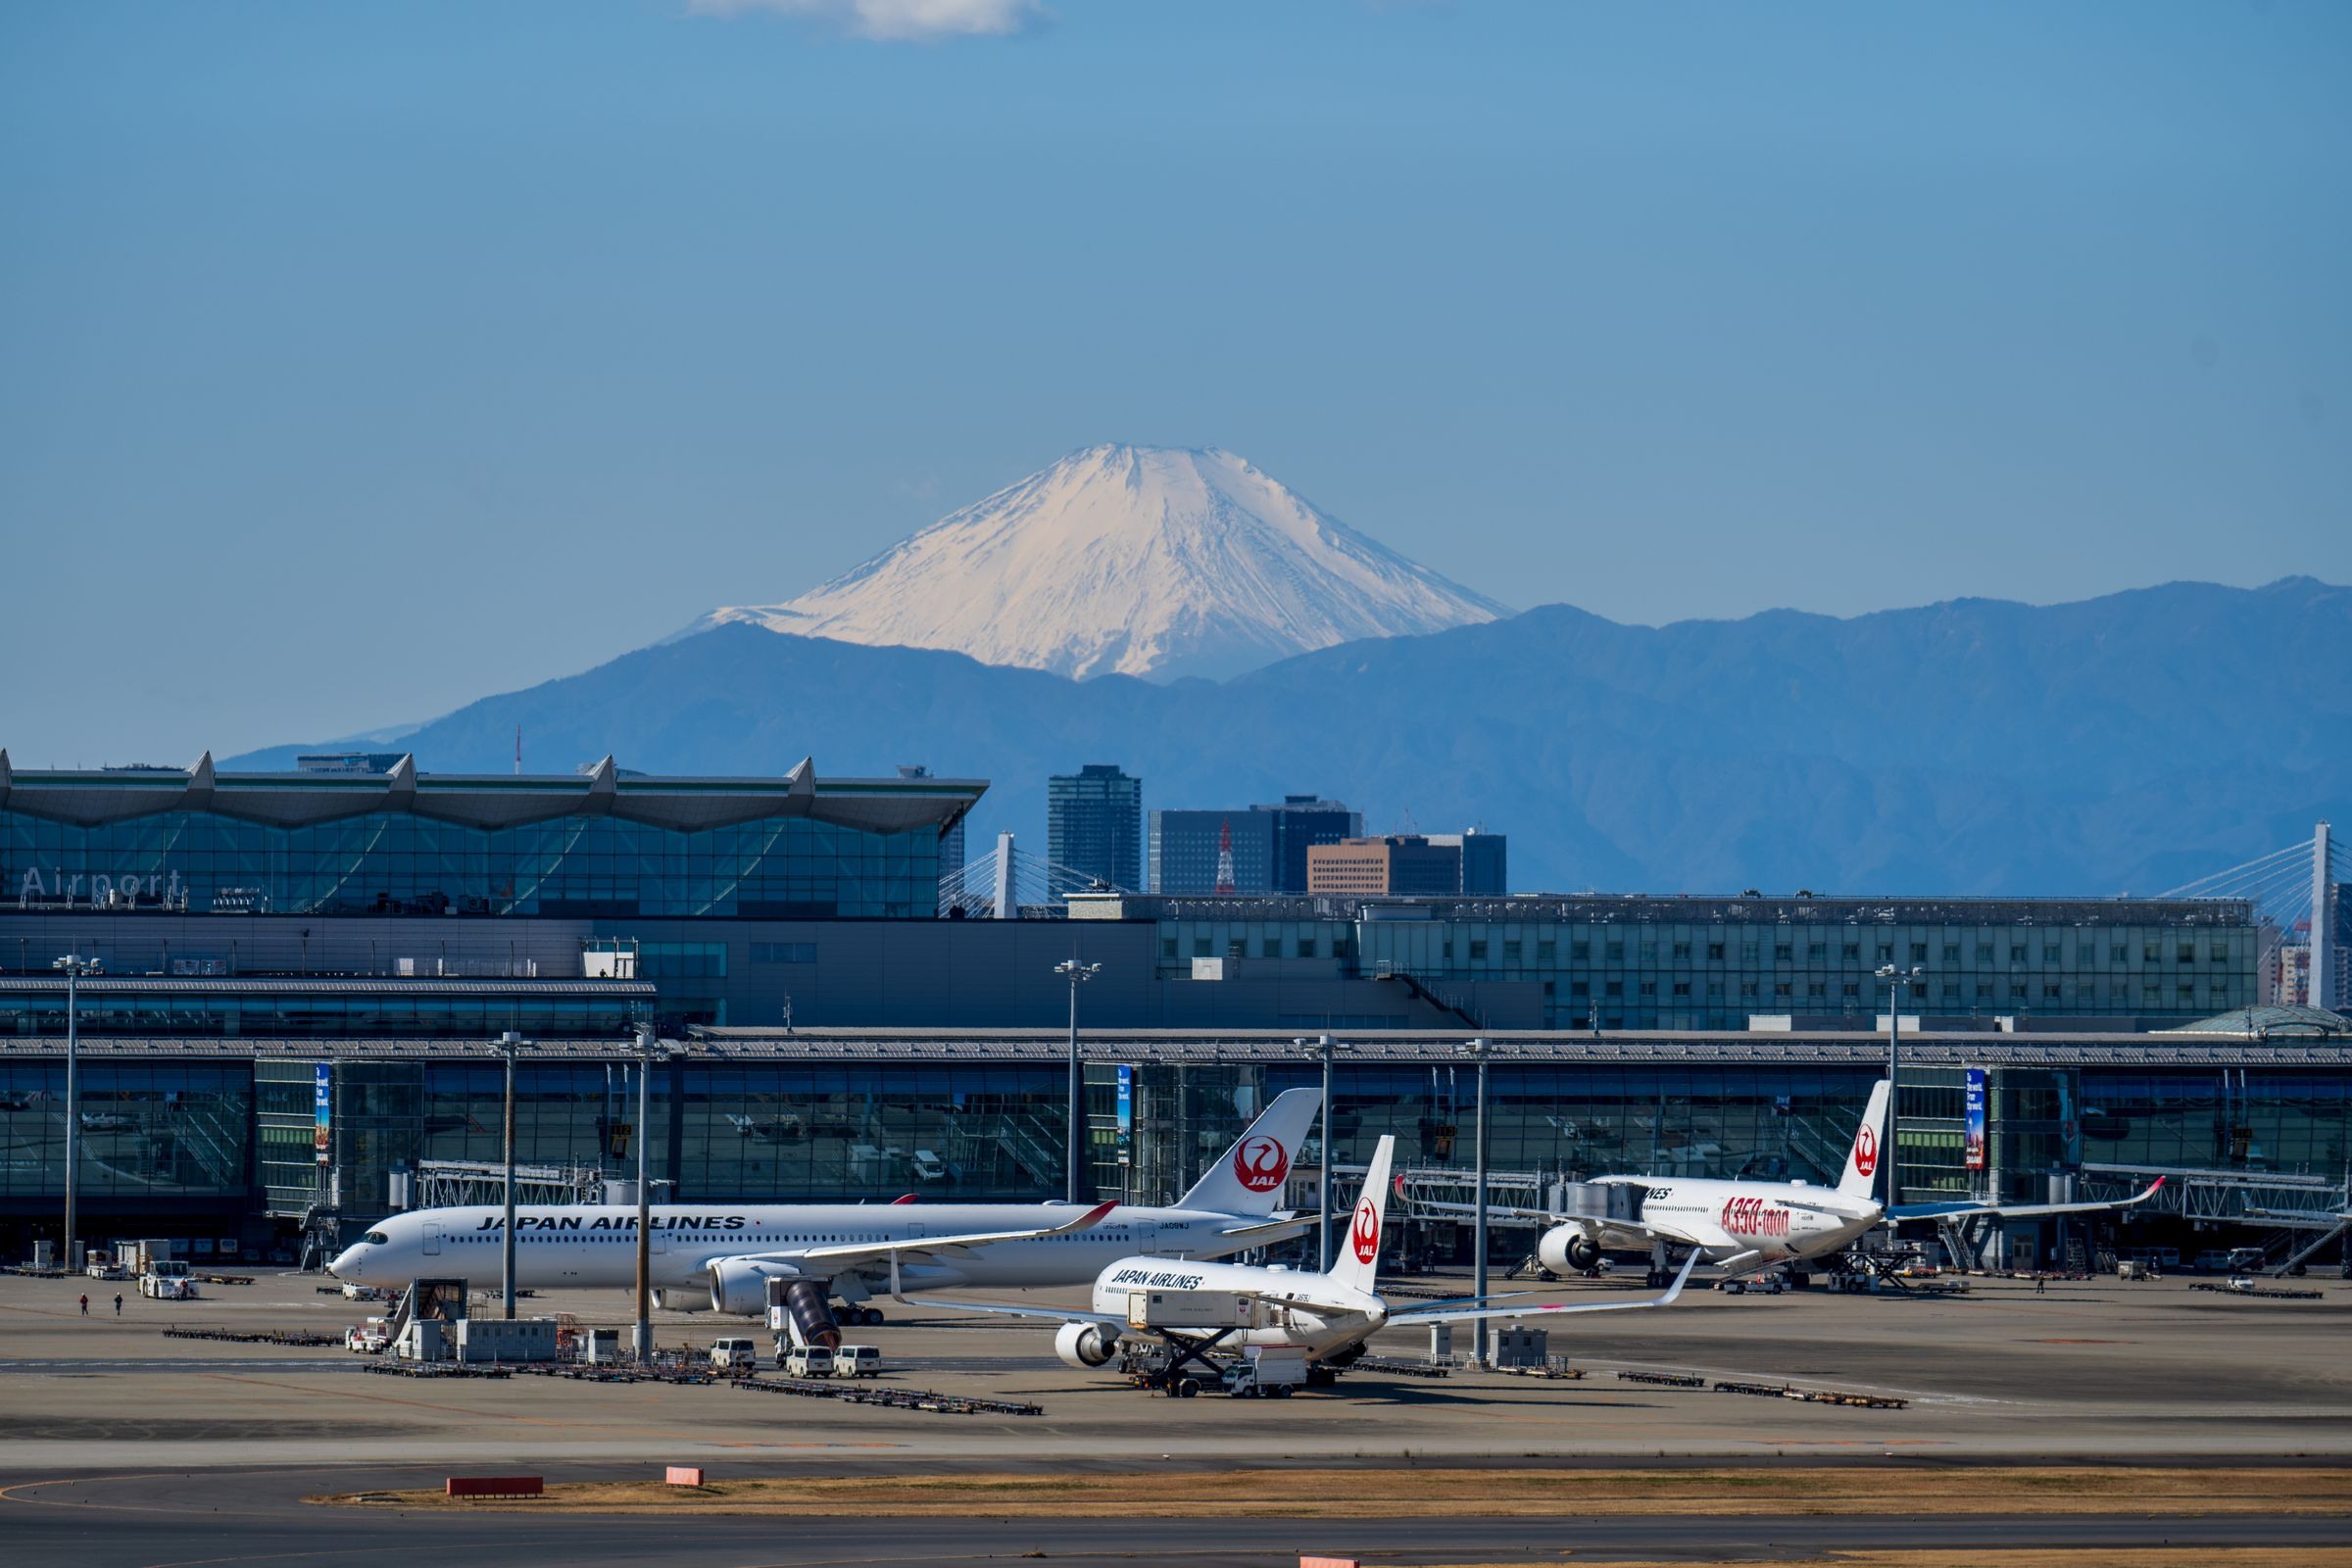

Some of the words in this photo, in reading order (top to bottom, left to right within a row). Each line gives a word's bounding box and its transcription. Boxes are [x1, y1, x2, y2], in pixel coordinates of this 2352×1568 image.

[21, 867, 180, 903] Airport
[1859, 1161, 1873, 1170] JAL
[1248, 1176, 1277, 1186] JAL
[476, 1217, 583, 1230] JAPAN
[590, 1216, 746, 1230] AIRLINES
[1722, 1197, 1789, 1237] A350-1000
[1359, 1246, 1374, 1255] JAL
[1111, 1269, 1152, 1286] JAPAN
[1147, 1272, 1203, 1290] AIRLINES
